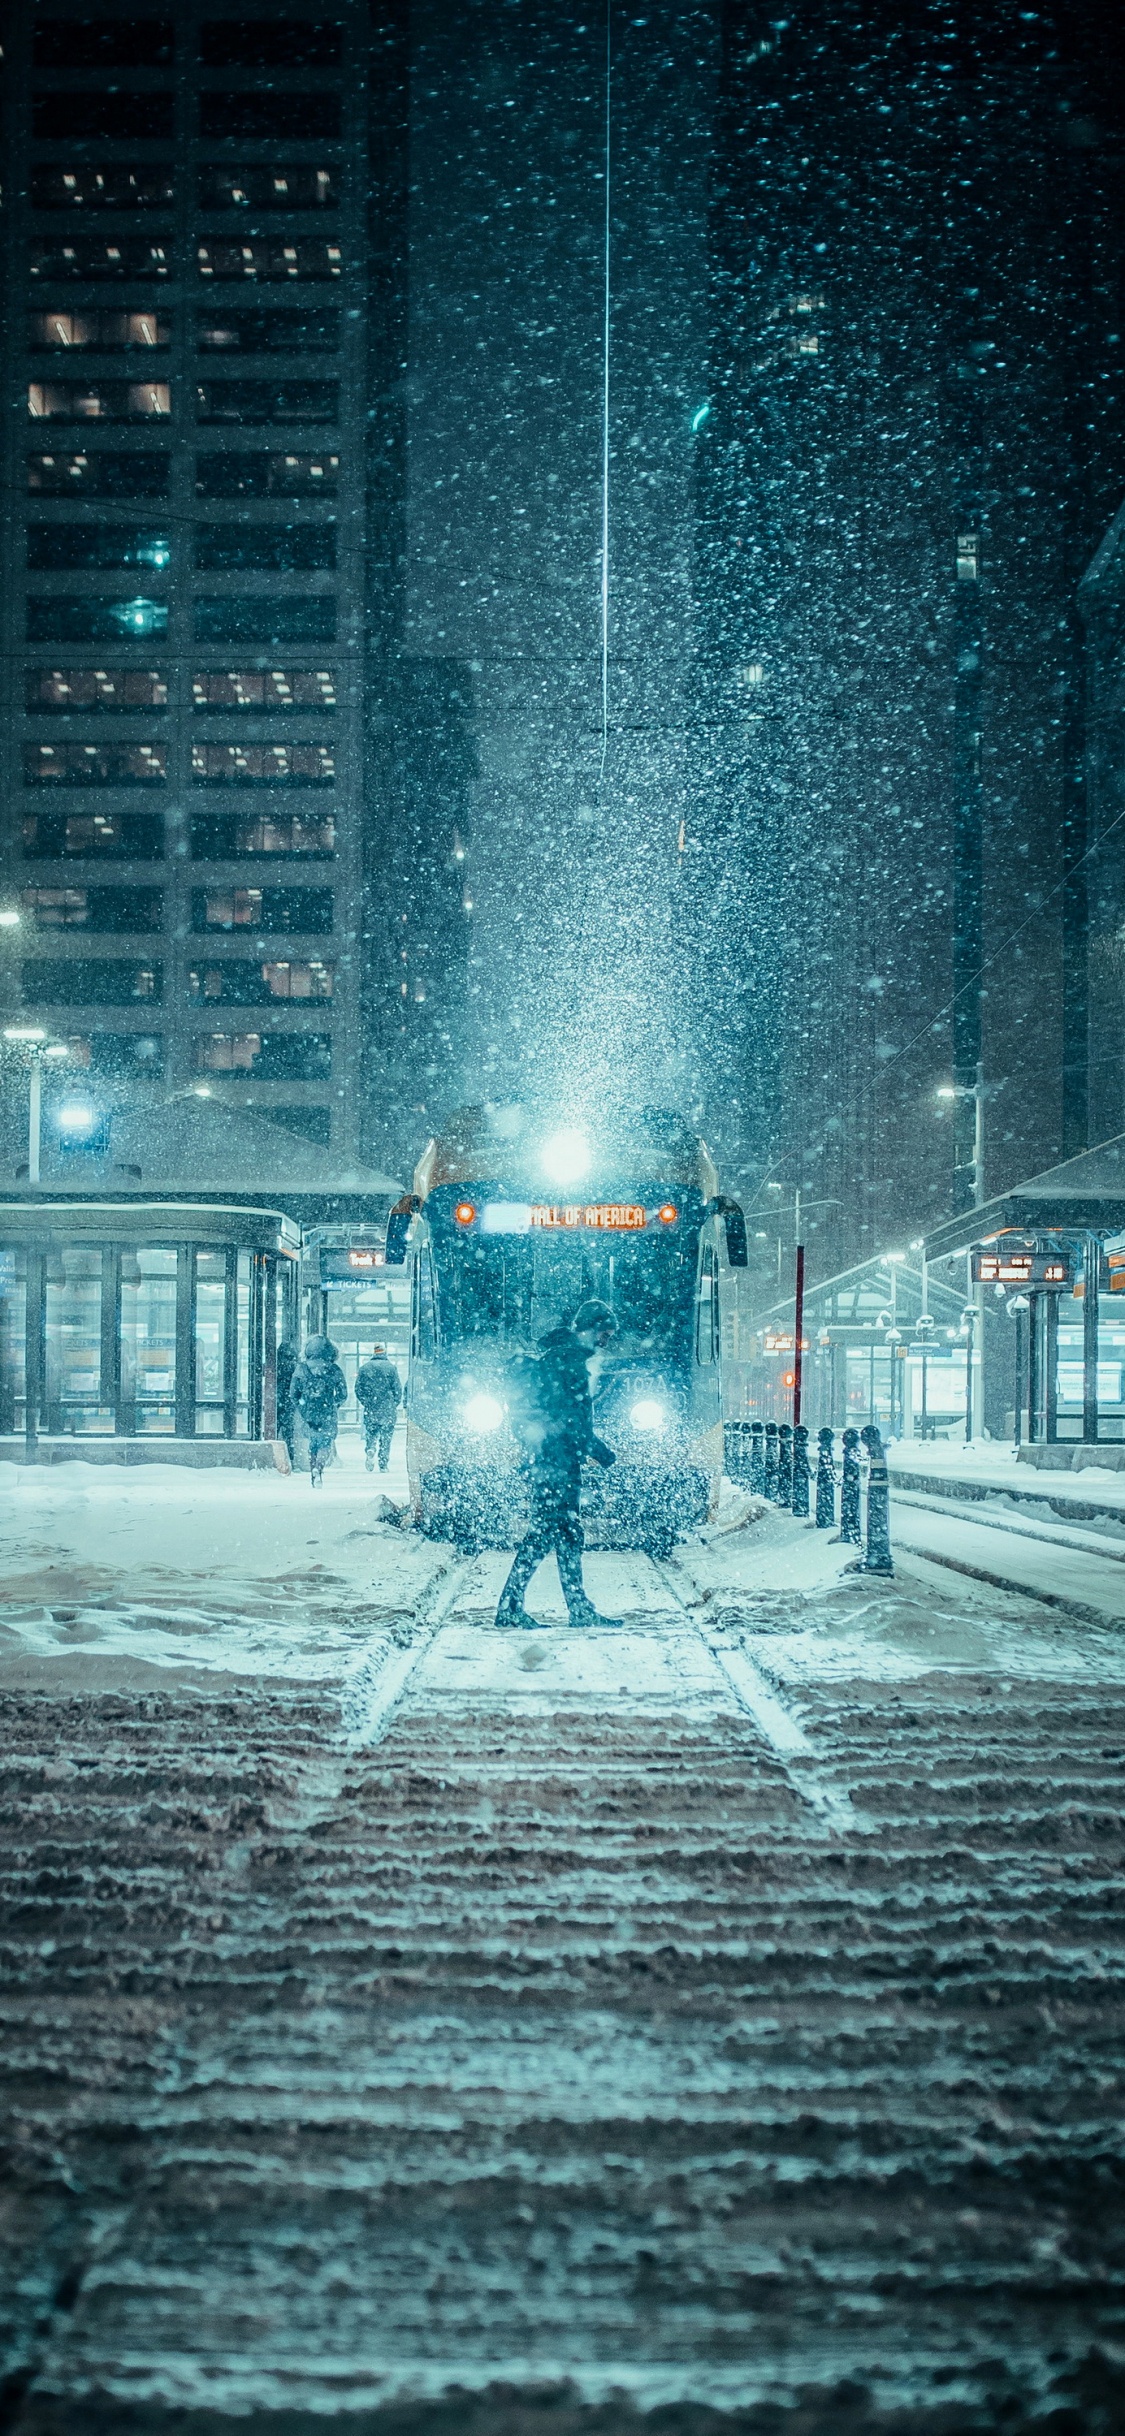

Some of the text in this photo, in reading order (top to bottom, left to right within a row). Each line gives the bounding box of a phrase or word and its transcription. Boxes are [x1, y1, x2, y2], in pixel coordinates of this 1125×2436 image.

[530, 1207, 643, 1226] MALL OF AMERICA
[623, 1376, 667, 1392] 107A
